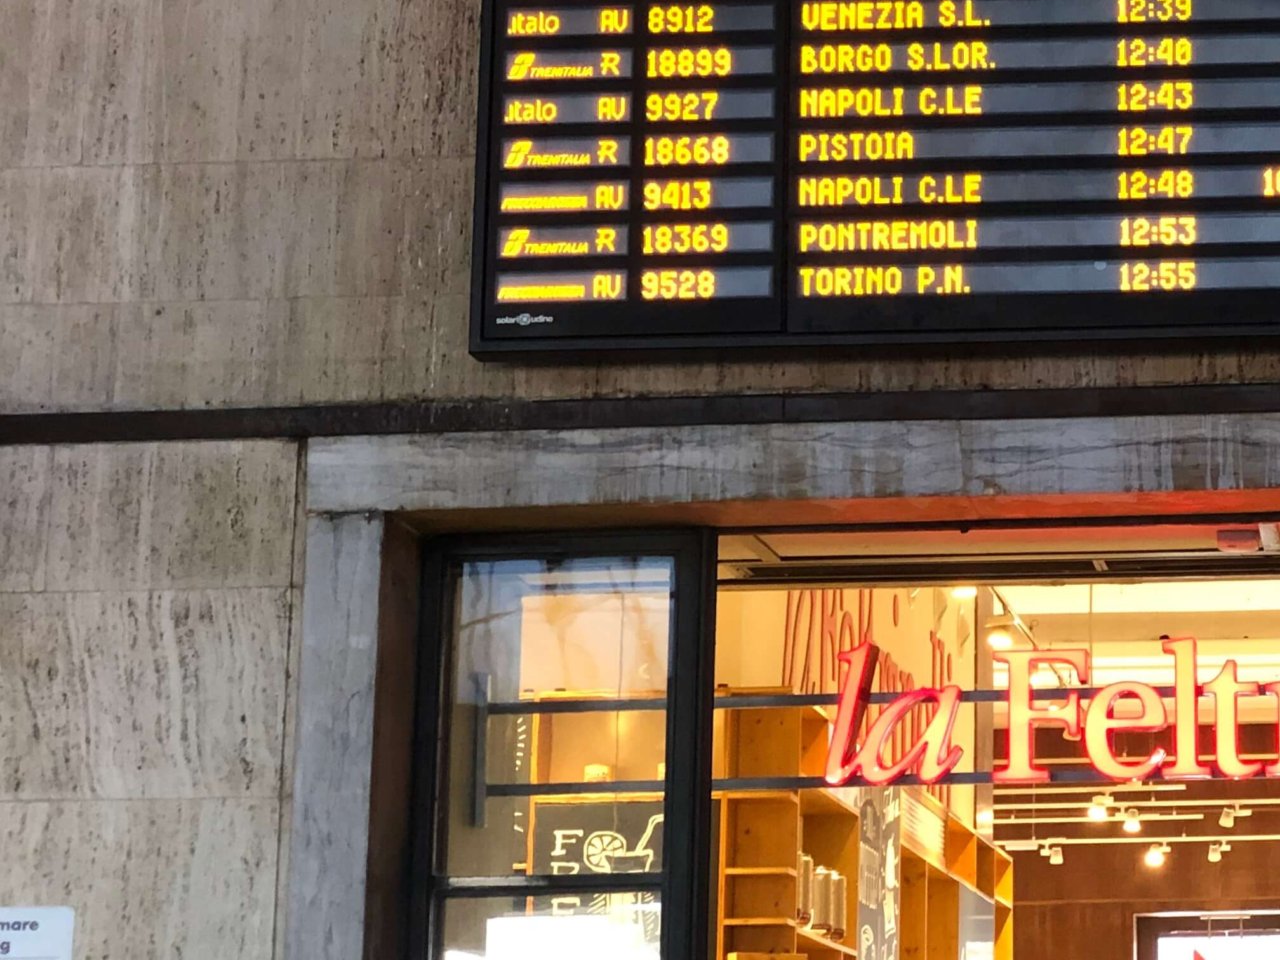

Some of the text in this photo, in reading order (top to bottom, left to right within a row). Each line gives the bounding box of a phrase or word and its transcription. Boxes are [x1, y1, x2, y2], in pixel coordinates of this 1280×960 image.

[648, 5, 714, 33] 8912
[802, 1, 923, 31] VENEZIA
[939, 0, 990, 27] S.L.
[647, 48, 732, 77] 18899
[801, 44, 892, 73] BORGO
[907, 41, 996, 70] S.LOR.
[1117, 38, 1192, 66] 12:40
[646, 92, 718, 121] 9927
[800, 88, 904, 117] NAPOLI
[919, 86, 982, 115] C.LE
[1117, 82, 1193, 111] 12:43
[644, 135, 729, 165] 18668
[800, 131, 914, 162] PISTOIA
[1117, 126, 1193, 155] 12:47
[643, 181, 711, 210] 9413
[799, 177, 903, 206] NAPOLI
[919, 174, 982, 203] C.LE
[1118, 170, 1193, 199] 12:48
[643, 223, 728, 254] 18369
[800, 220, 977, 252] PONTREMOLI
[1120, 217, 1197, 246] 12:53
[641, 270, 715, 299] 9528
[799, 266, 902, 296] TORINO
[917, 265, 970, 294] P.N.
[1119, 262, 1196, 291] 12:55
[825, 639, 964, 788] la
